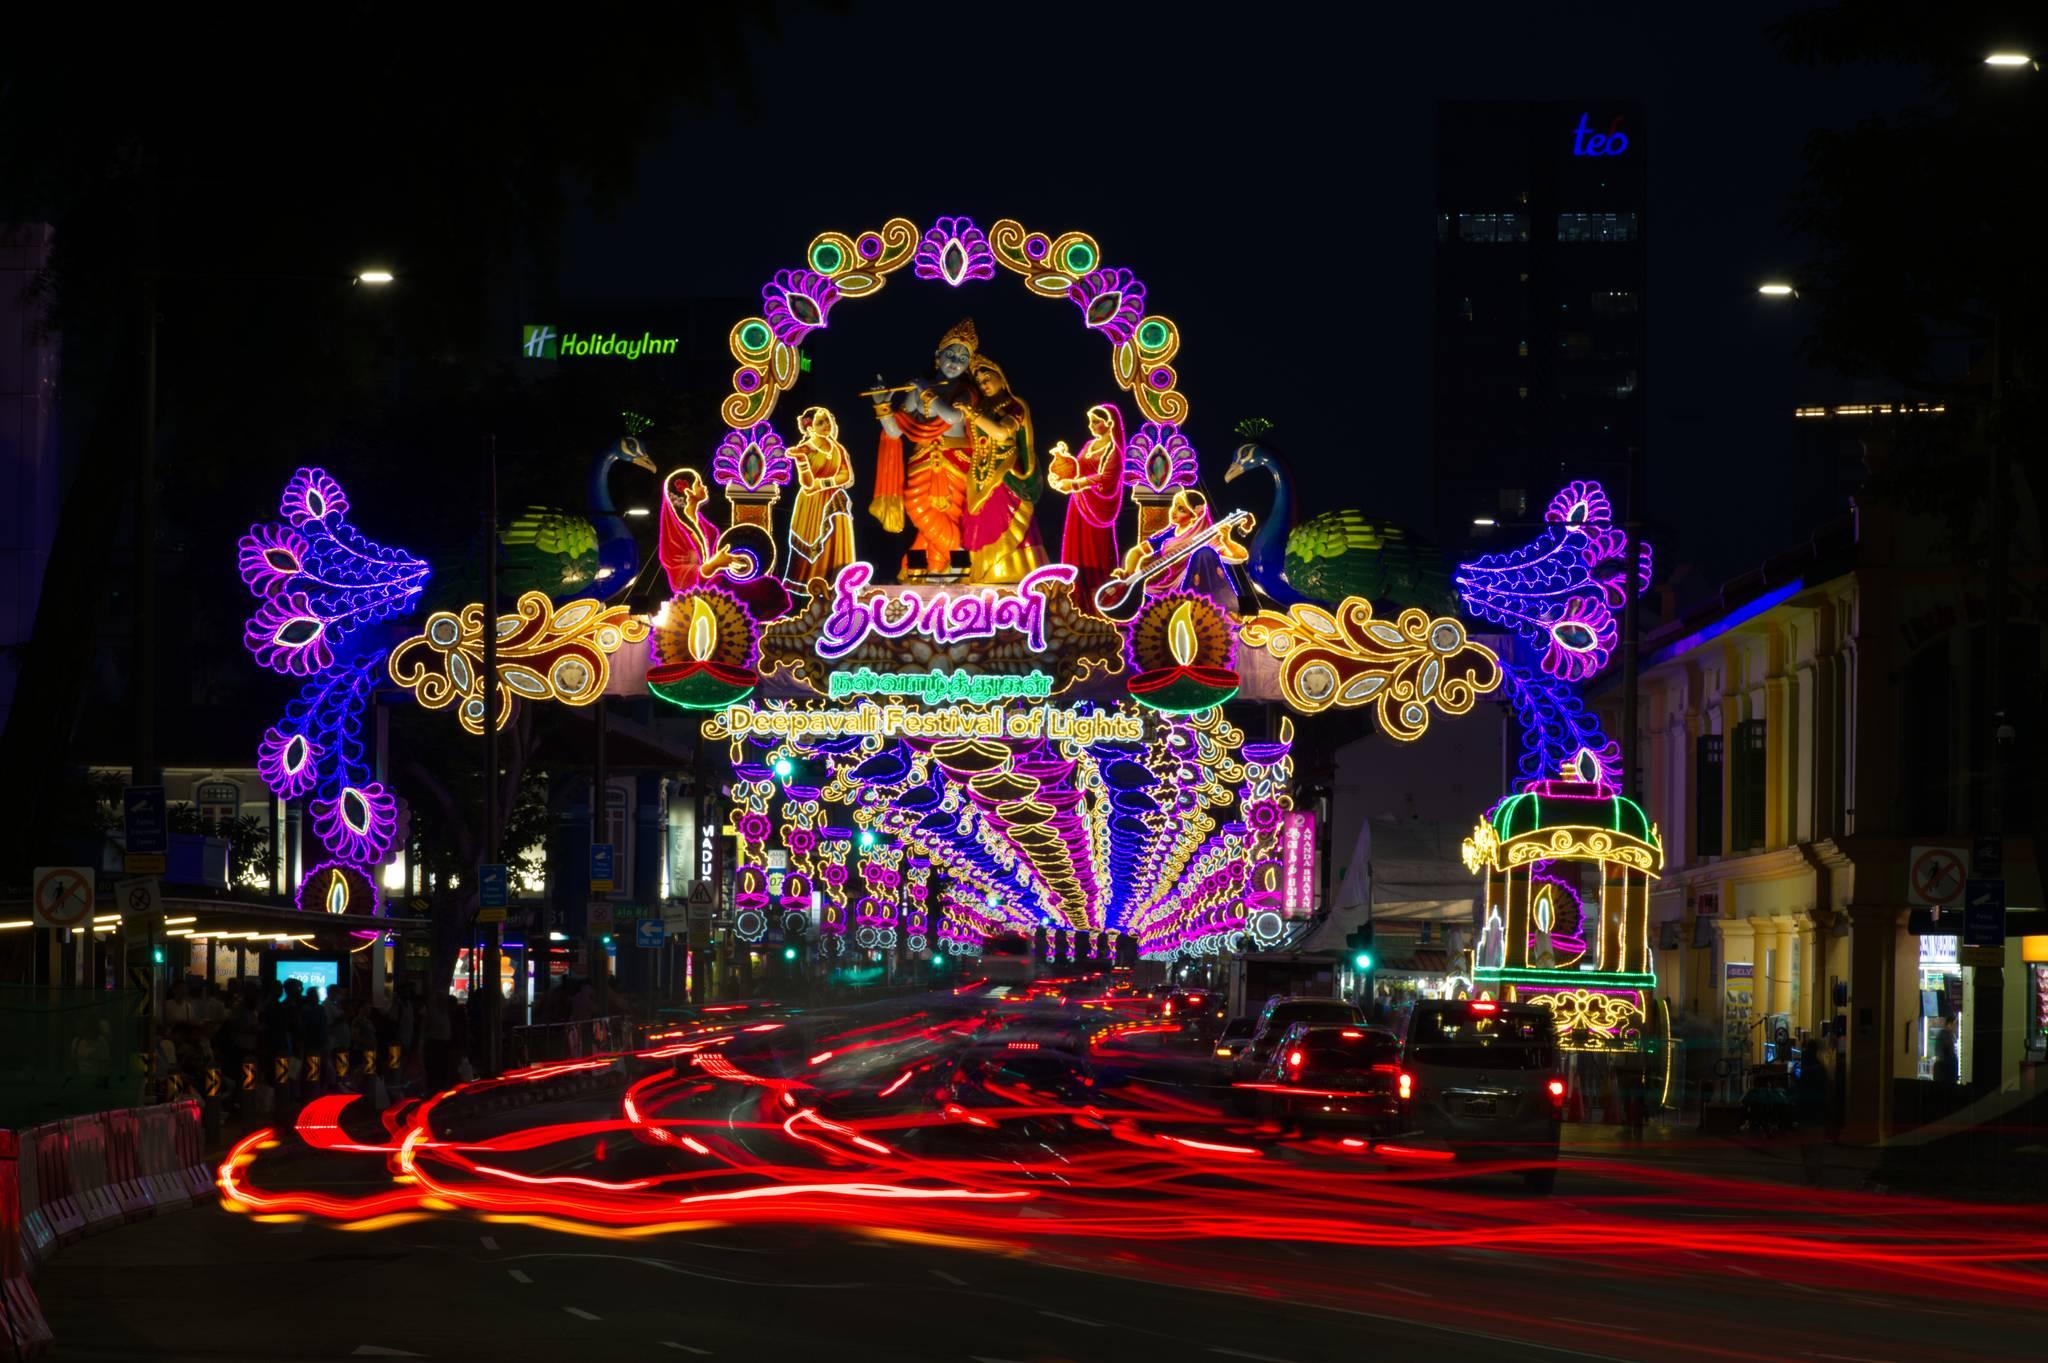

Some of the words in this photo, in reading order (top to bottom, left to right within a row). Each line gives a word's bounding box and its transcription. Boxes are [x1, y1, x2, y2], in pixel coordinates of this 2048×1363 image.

[816, 561, 1077, 658] தீபாவளி
[730, 706, 878, 741] Deepavali
[885, 705, 1001, 737] Festival
[1009, 710, 1042, 738] of
[1048, 711, 1142, 744] Lights
